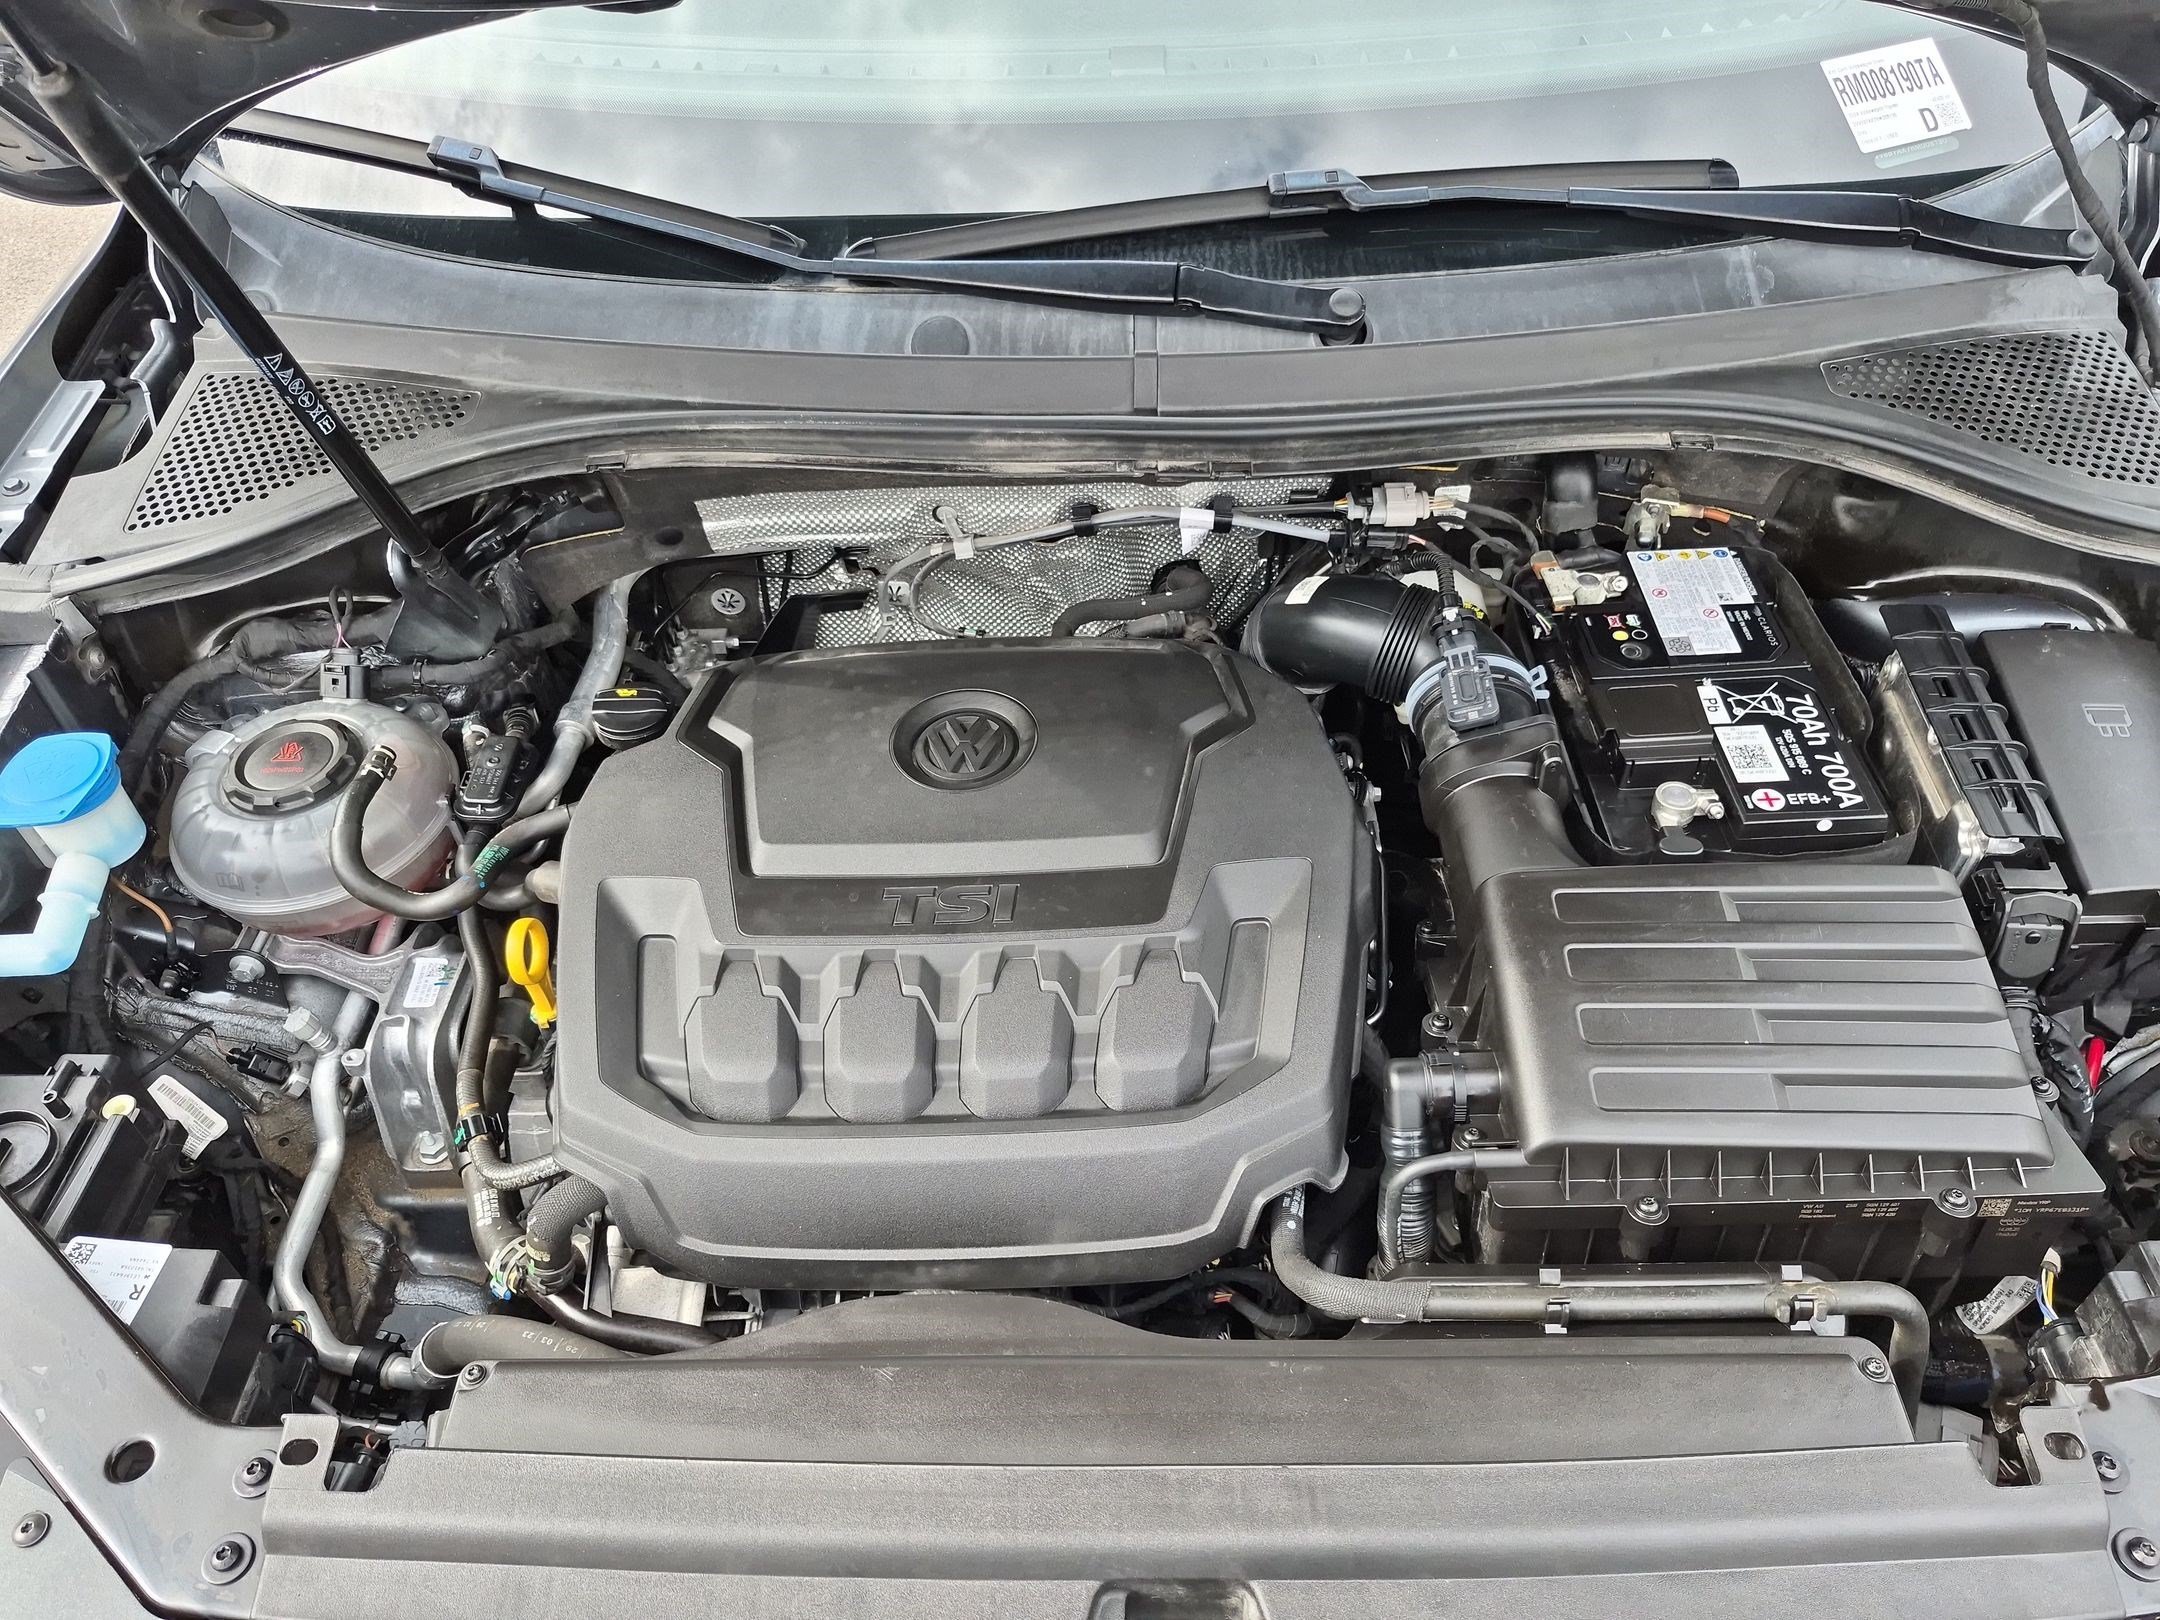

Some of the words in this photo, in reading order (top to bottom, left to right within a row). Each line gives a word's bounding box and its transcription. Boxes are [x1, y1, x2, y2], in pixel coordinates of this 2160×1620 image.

[1832, 57, 1944, 107] RM008190TA
[1918, 108, 1939, 133] D
[1742, 626, 1754, 641] MEXICO
[1757, 617, 1779, 647] CLARIOS
[1703, 697, 1719, 713] Pb
[1785, 693, 1831, 746] 70Ah
[1814, 751, 1864, 809] 700A
[1789, 743, 1802, 755] 915
[1786, 792, 1832, 805] EFB+
[881, 884, 1020, 926] TSI
[129, 1284, 146, 1301] R
